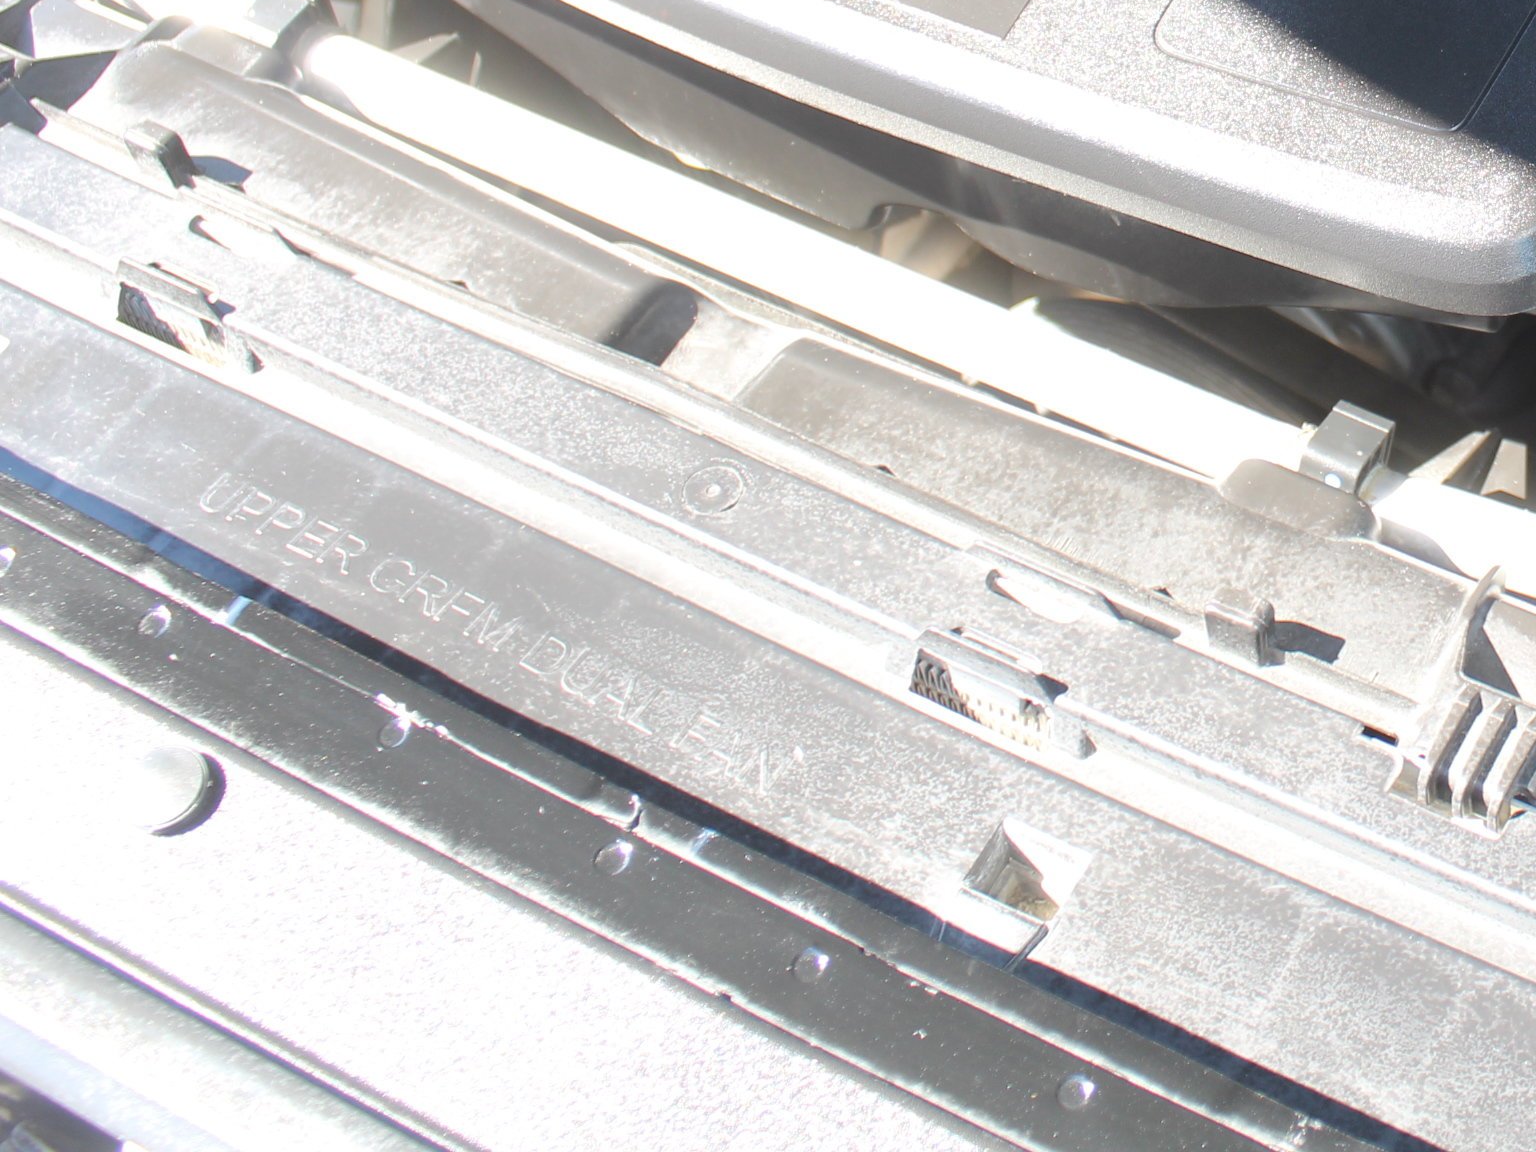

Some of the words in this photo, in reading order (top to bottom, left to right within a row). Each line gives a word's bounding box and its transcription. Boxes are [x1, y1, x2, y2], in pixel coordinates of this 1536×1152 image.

[199, 473, 369, 575] UPPER
[519, 634, 661, 733] DUAL
[671, 712, 795, 795] FAN
